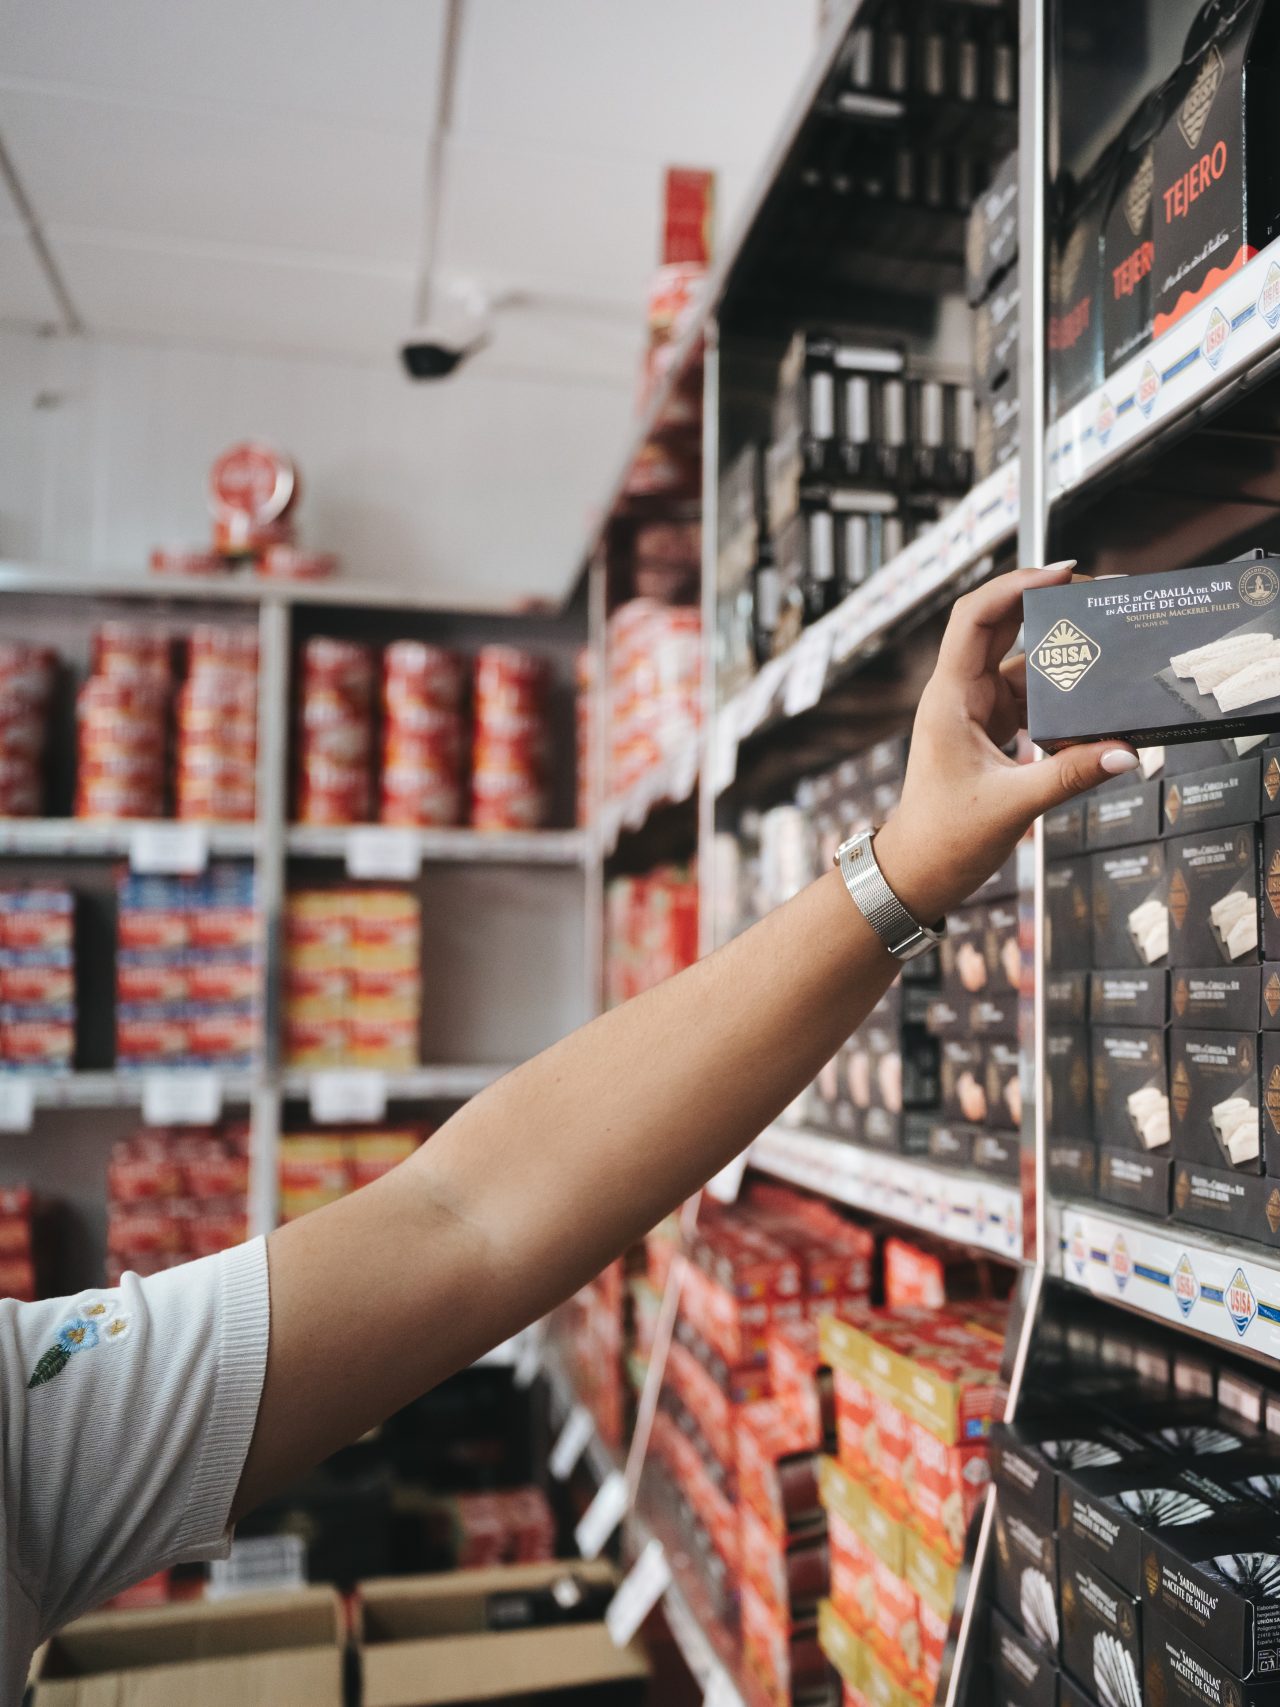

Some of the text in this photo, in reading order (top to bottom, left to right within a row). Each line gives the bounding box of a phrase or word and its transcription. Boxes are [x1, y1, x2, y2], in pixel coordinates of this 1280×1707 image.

[1163, 140, 1227, 224] TEJERO
[1087, 594, 1130, 608] FILETES
[1143, 586, 1194, 601] CABALLA
[1210, 581, 1233, 593] SUR
[1116, 601, 1156, 615] ACEITE
[1159, 600, 1174, 609] DE
[1177, 594, 1213, 606] OLIVA
[1126, 602, 1240, 622] SOUTHERN MACKEREL FILLETS
[1038, 645, 1093, 666] USISA
[1230, 1288, 1252, 1316] USISA
[1167, 1580, 1210, 1620] ACEITE DE OLIVA
[1176, 1660, 1220, 1704] ACEITE DE OLIVA
